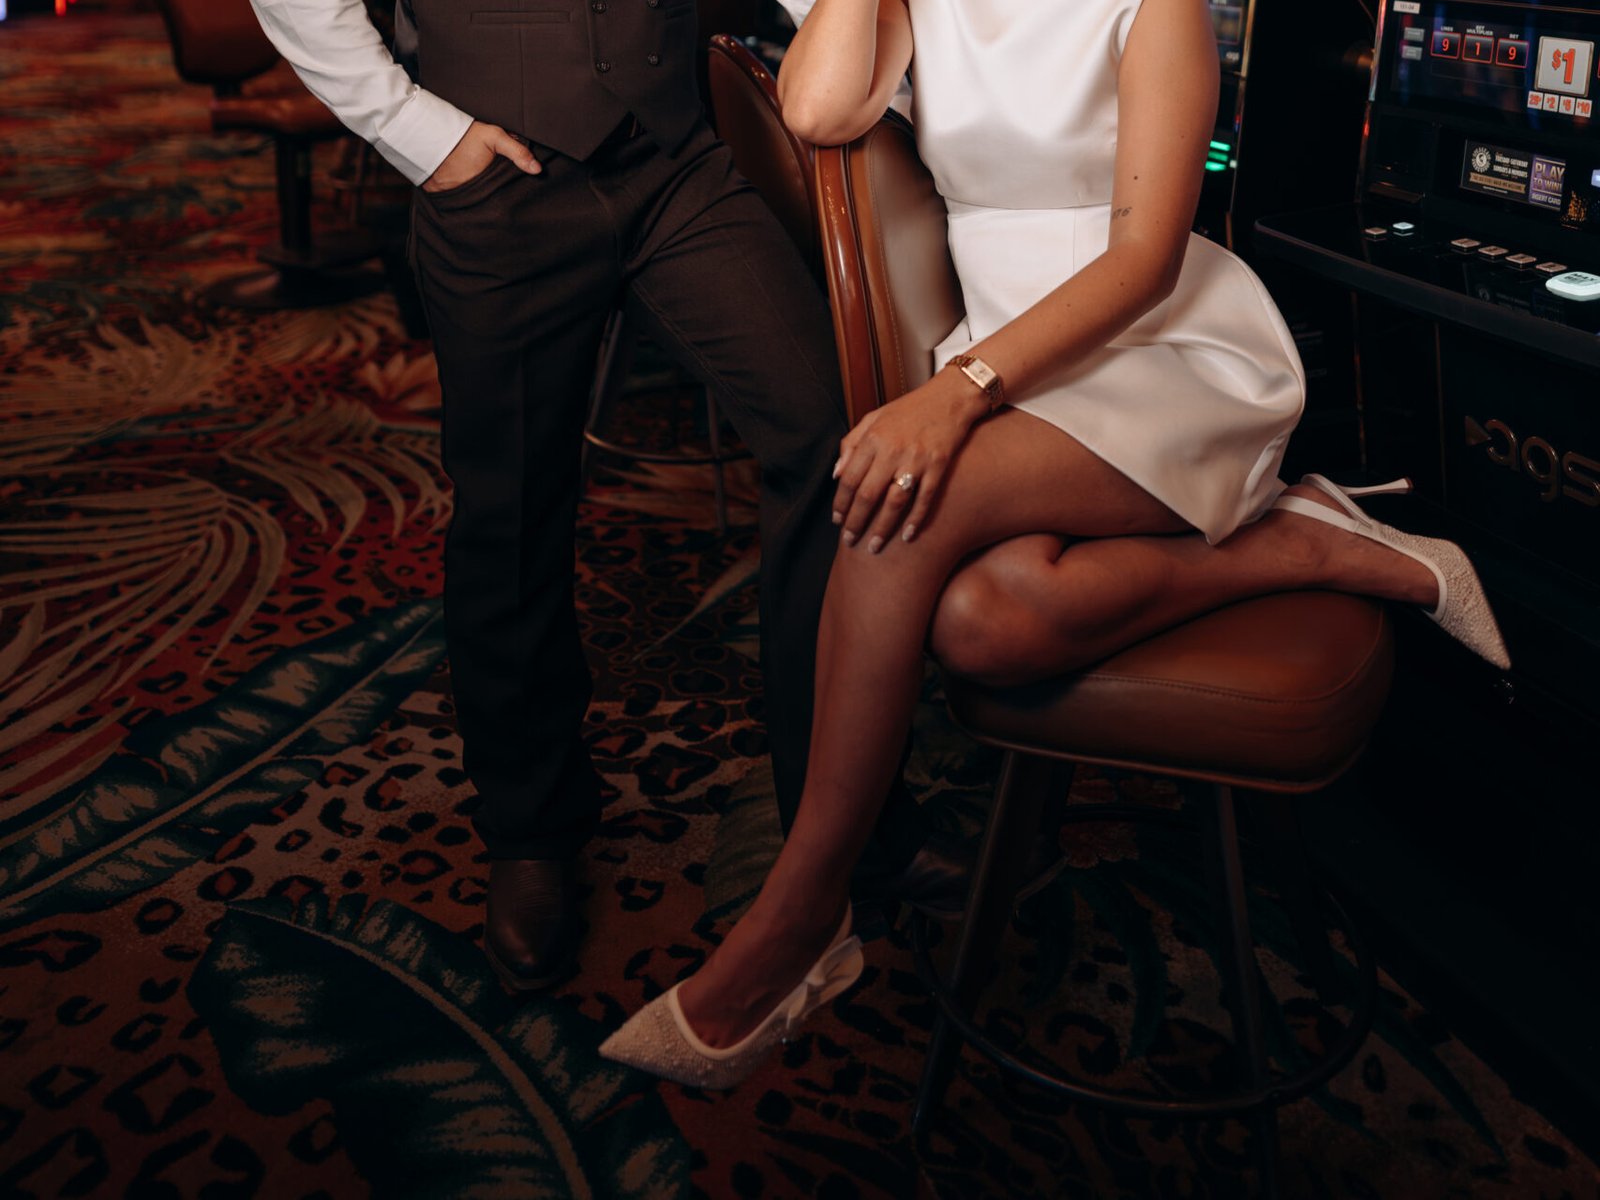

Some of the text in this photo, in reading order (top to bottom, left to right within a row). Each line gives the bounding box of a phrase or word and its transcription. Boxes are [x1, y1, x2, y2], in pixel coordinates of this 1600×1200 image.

[1442, 38, 1516, 60] 9 1 9
[1552, 48, 1575, 84] $1
[1535, 162, 1565, 181] PLAY
[1533, 177, 1543, 190] TO
[1545, 180, 1562, 193] WIN!
